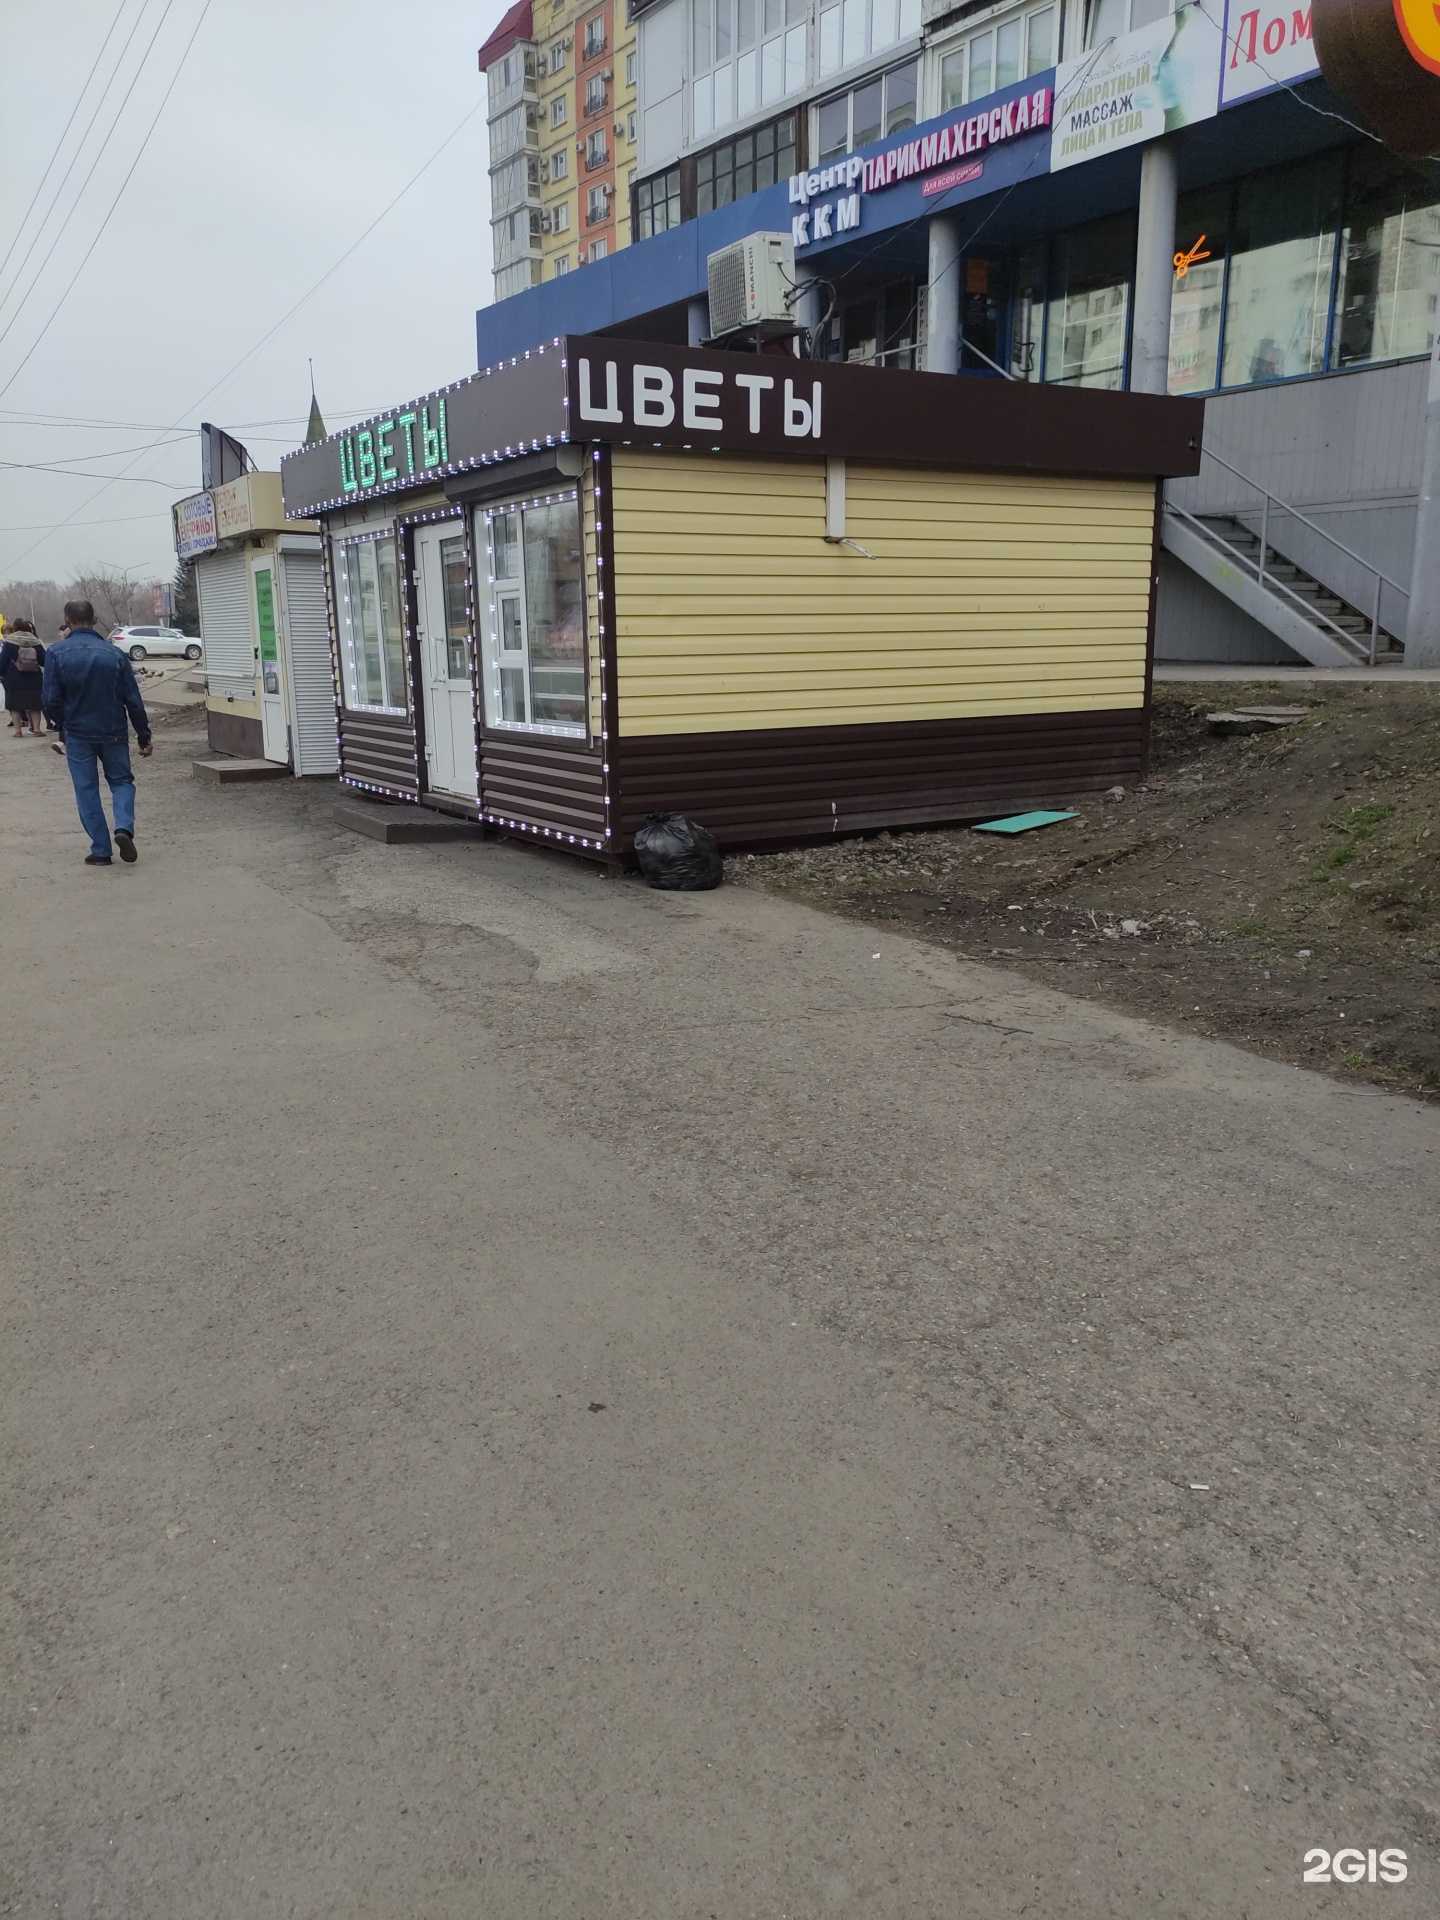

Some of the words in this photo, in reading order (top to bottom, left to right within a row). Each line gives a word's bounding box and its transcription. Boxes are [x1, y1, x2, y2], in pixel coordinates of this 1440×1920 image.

[862, 88, 1049, 193] ПАРИКМАХЕРСКАЯ
[1061, 131, 1095, 157] ЛИЦА
[1096, 124, 1106, 144] И
[1108, 111, 1143, 140] ТЕЛА
[1071, 93, 1133, 132] МАССАЖ
[789, 156, 864, 205] Центр
[578, 358, 822, 439] ЦВЕТЫ
[339, 398, 448, 493] ЦВЕТЫ
